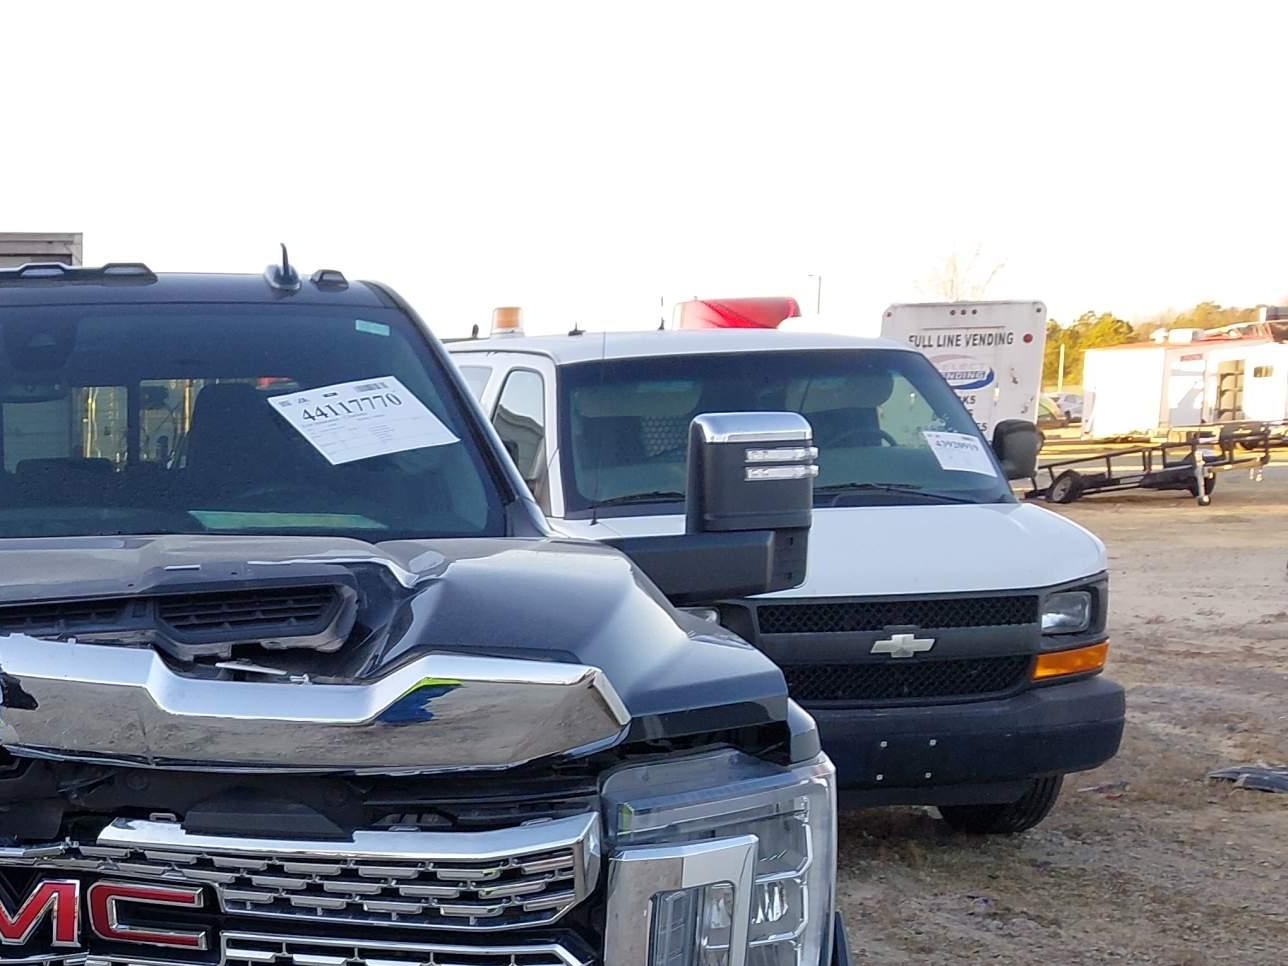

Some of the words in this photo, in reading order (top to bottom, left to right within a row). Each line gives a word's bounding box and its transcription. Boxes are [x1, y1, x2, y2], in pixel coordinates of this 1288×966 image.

[937, 334, 961, 347] LINE
[965, 332, 1014, 347] VENDING
[302, 393, 402, 421] 44117770
